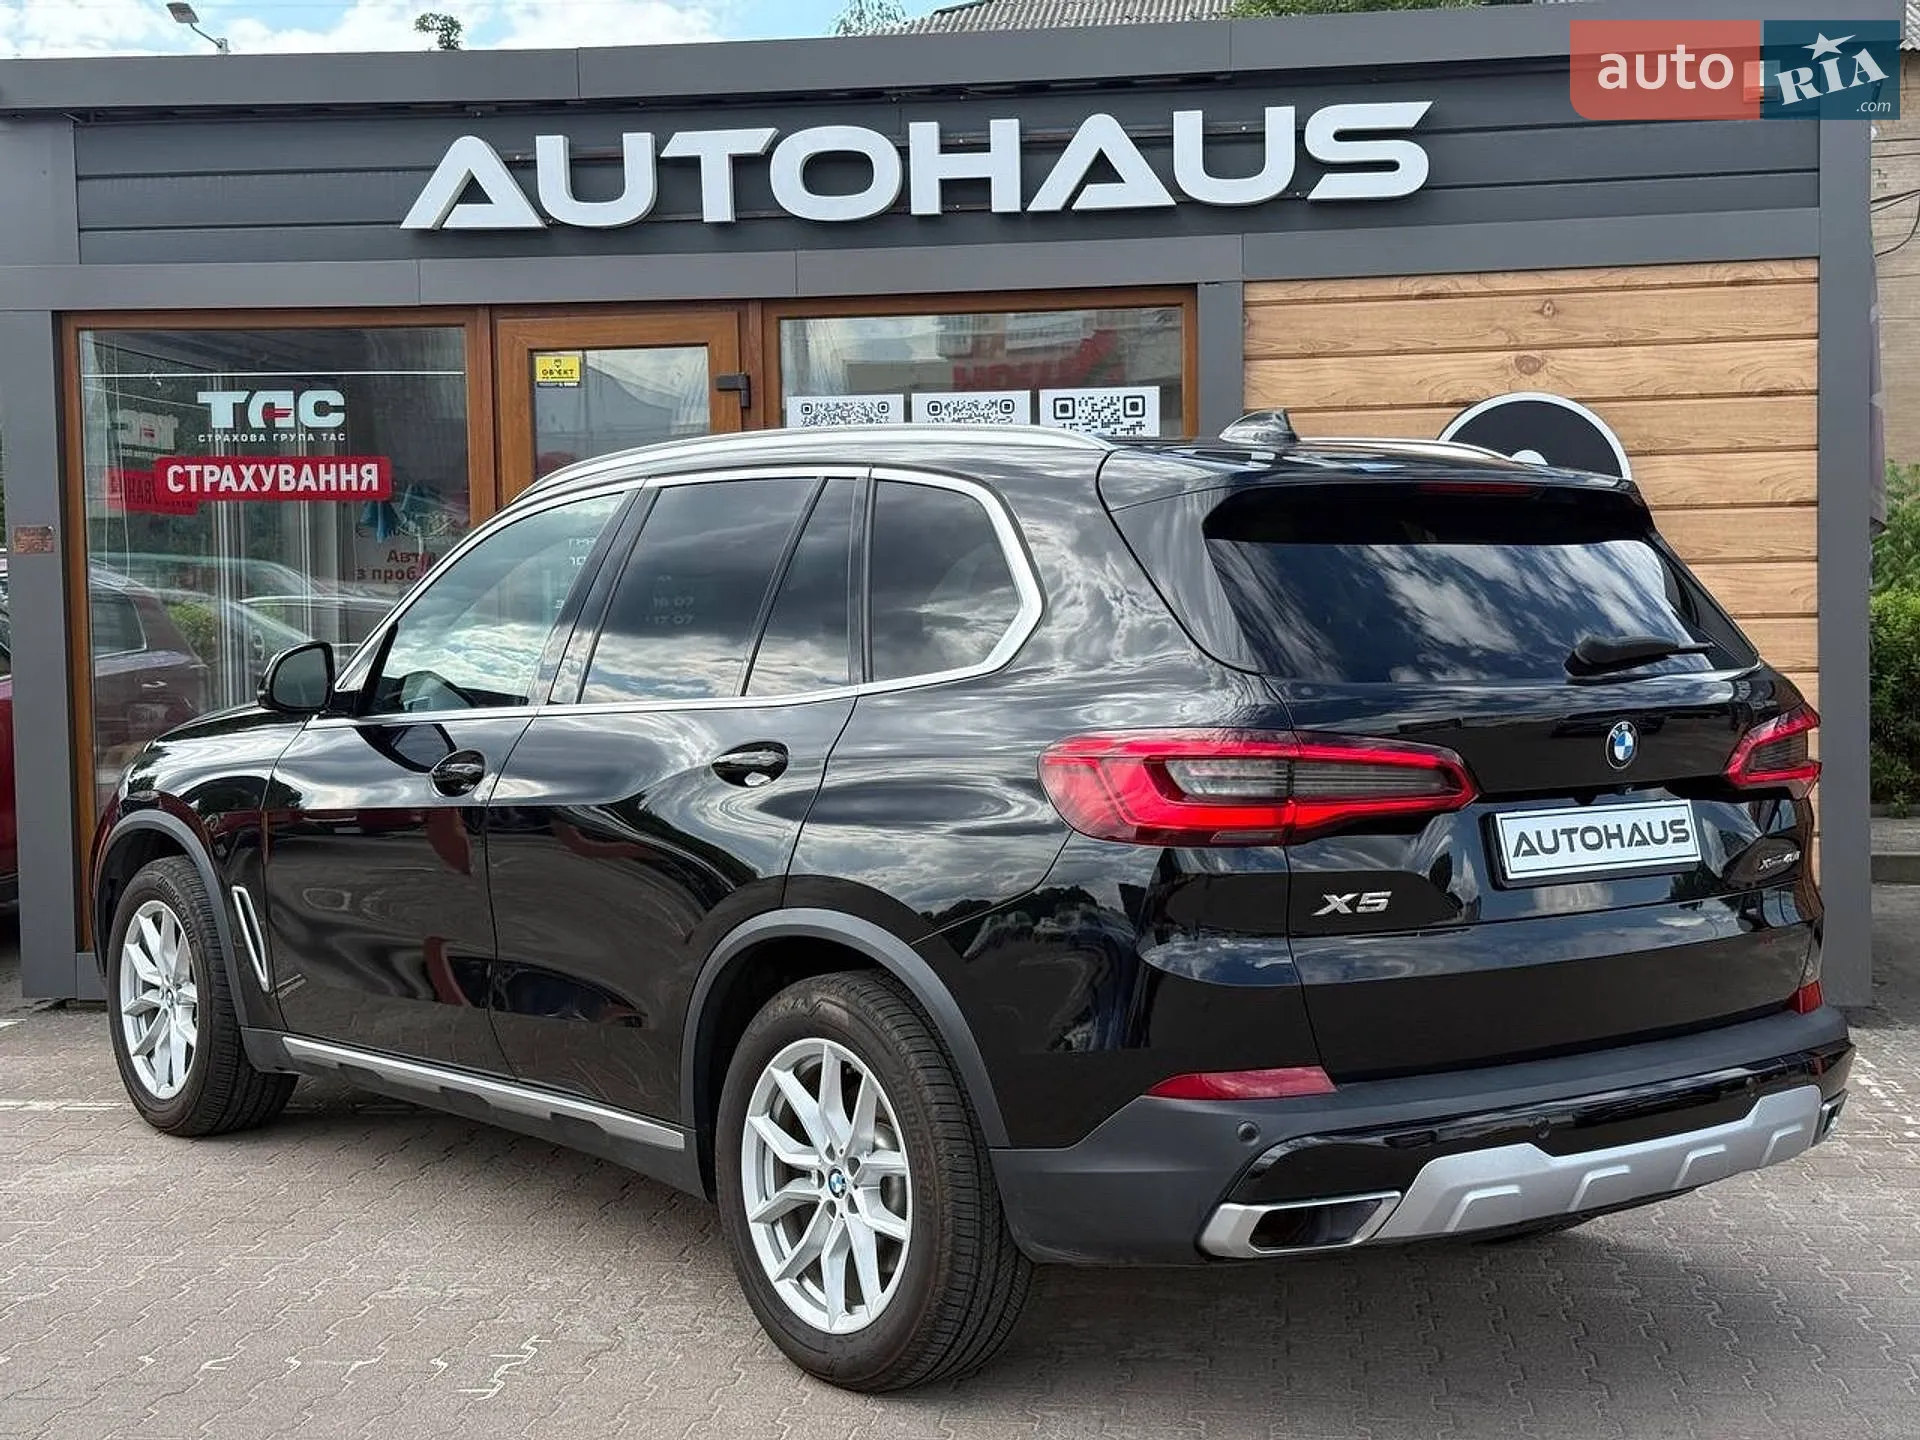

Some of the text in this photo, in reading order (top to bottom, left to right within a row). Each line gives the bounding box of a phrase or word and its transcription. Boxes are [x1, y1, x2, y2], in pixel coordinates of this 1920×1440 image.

[400, 101, 1433, 230] AUTOHAUS
[198, 433, 346, 443] СТРАХОВА ГРУПА ТАС
[166, 463, 379, 493] СТРАХУВАННЯ
[1512, 819, 1691, 858] AUTOHAUS
[1311, 891, 1393, 916] X5
